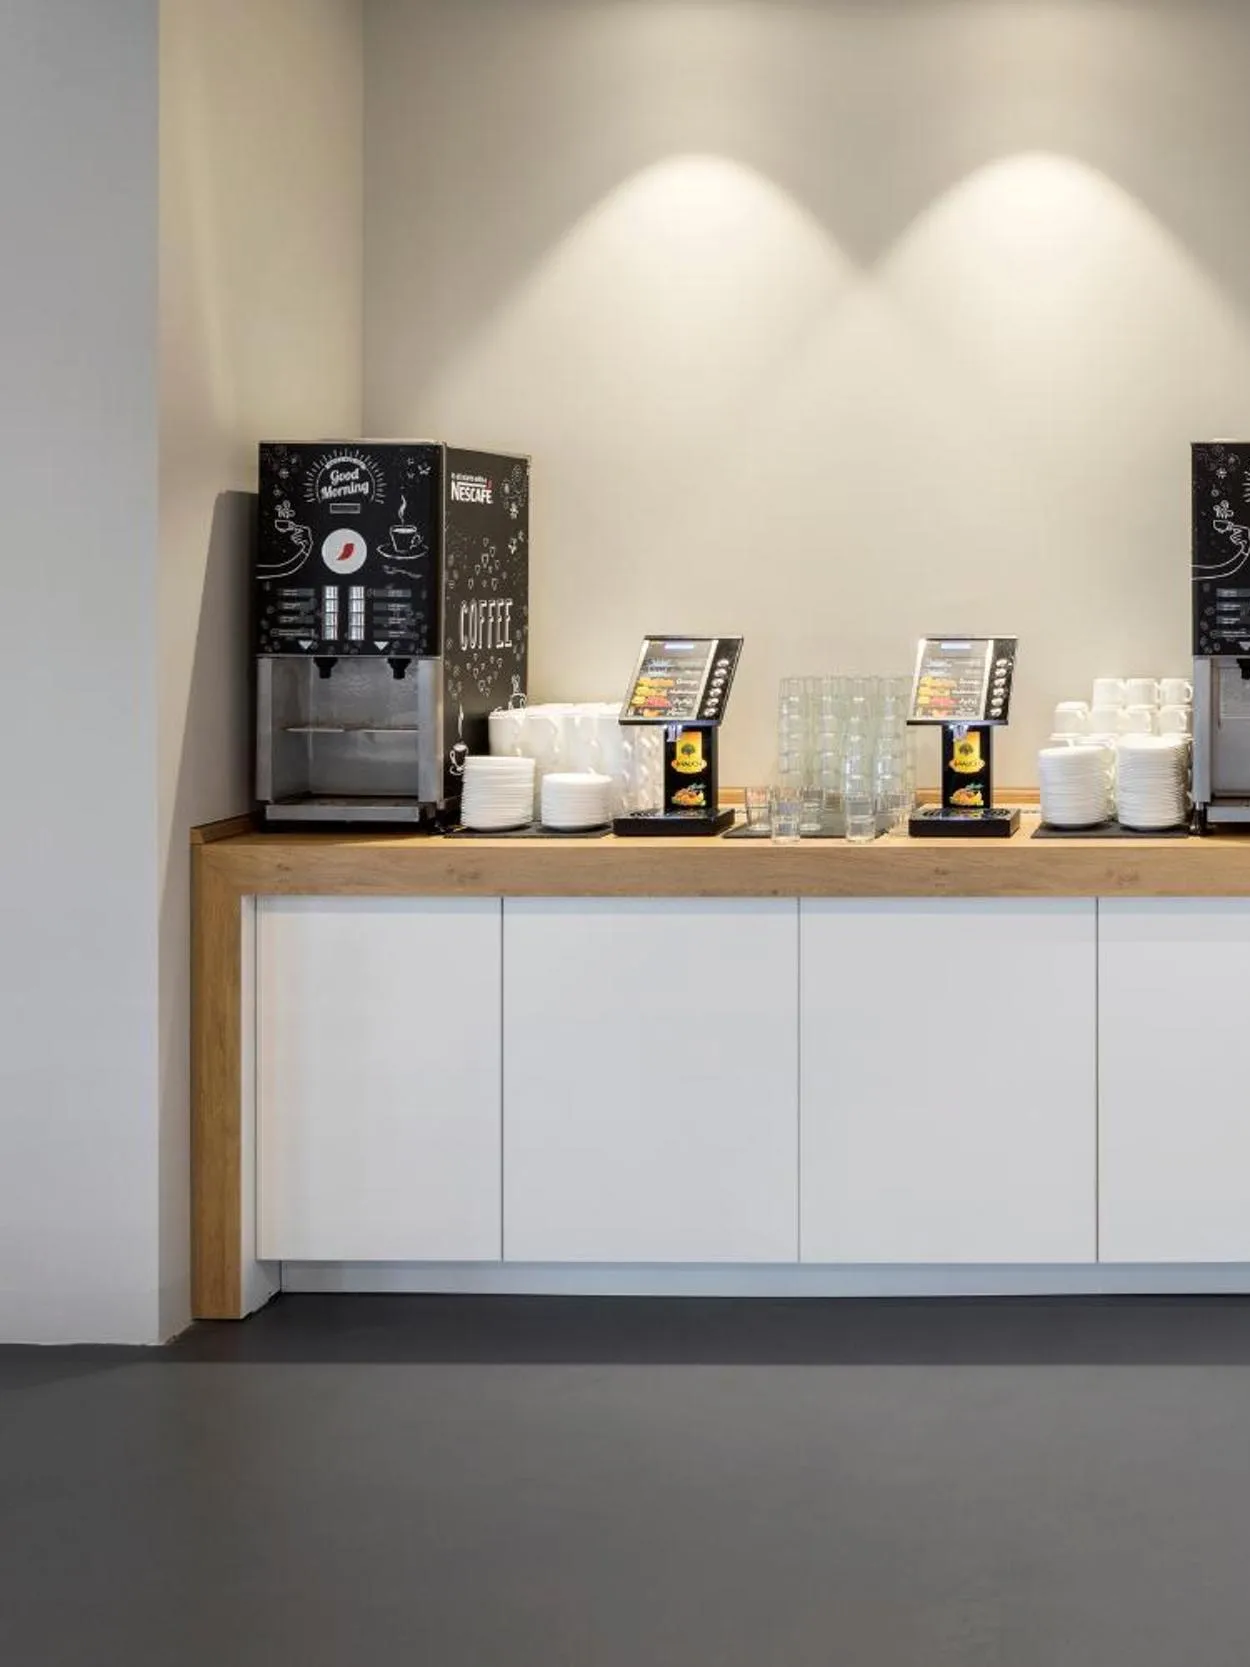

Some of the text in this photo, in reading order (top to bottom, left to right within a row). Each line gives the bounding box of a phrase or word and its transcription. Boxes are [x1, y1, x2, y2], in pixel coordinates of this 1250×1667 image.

[331, 468, 359, 486] Good
[321, 481, 370, 500] Morning
[460, 598, 513, 651] COFFEE
